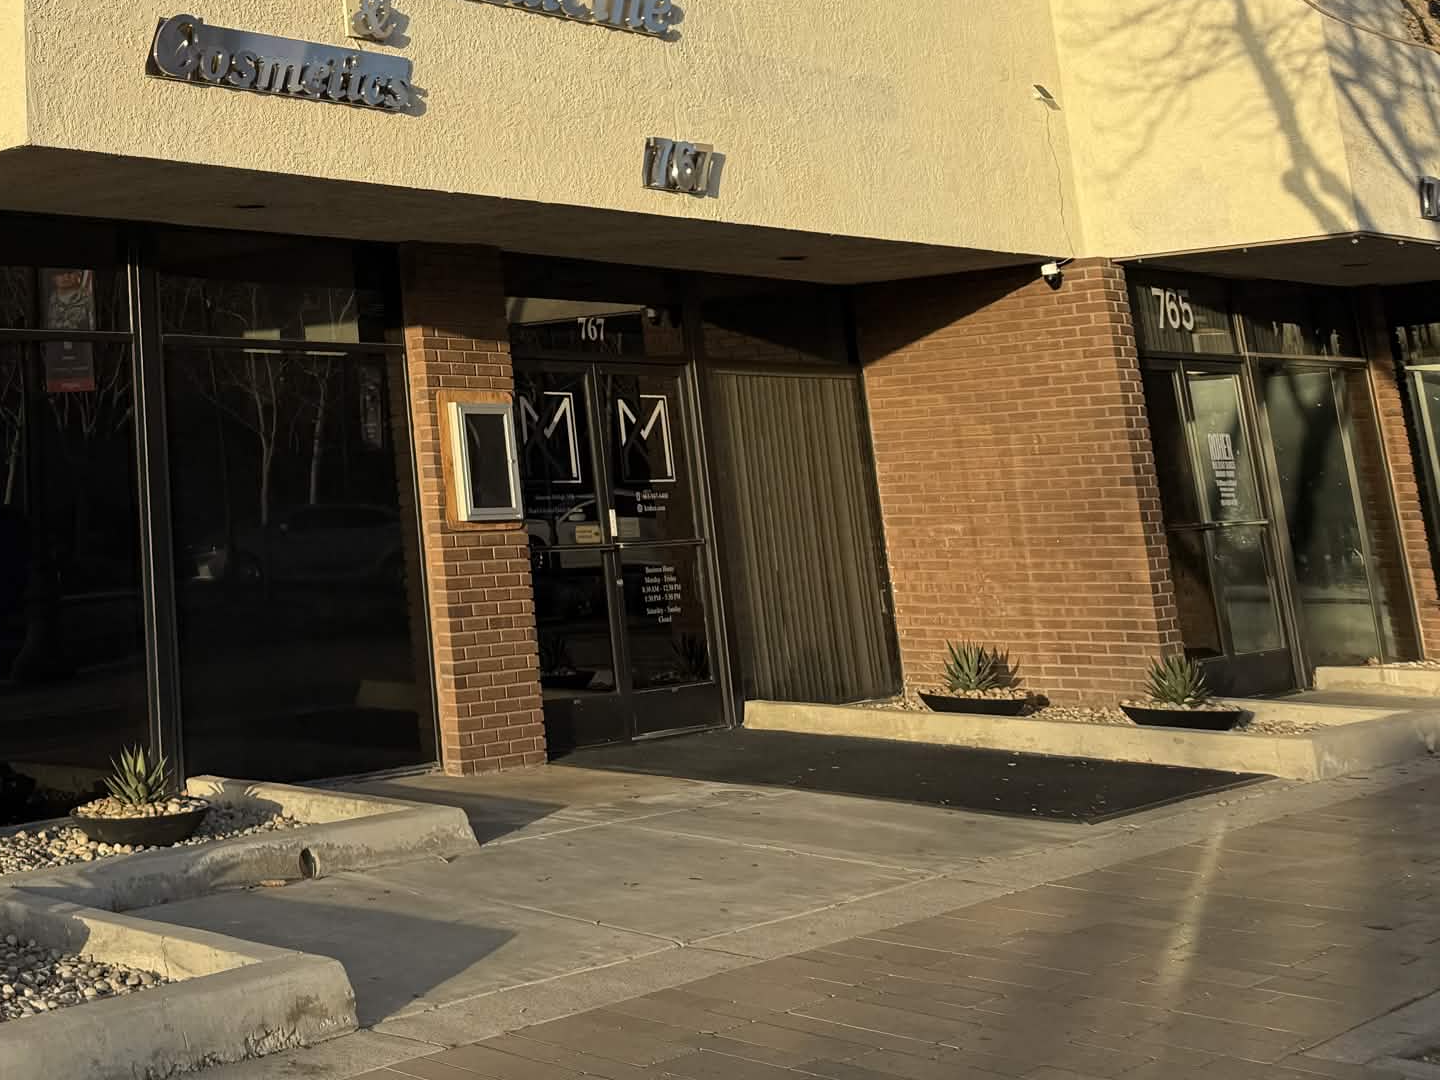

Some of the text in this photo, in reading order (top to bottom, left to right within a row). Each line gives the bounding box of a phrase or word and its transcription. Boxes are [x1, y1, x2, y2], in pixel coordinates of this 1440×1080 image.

[153, 14, 411, 110] Cosmetics
[577, 317, 605, 341] 767
[1151, 287, 1194, 330] 765
